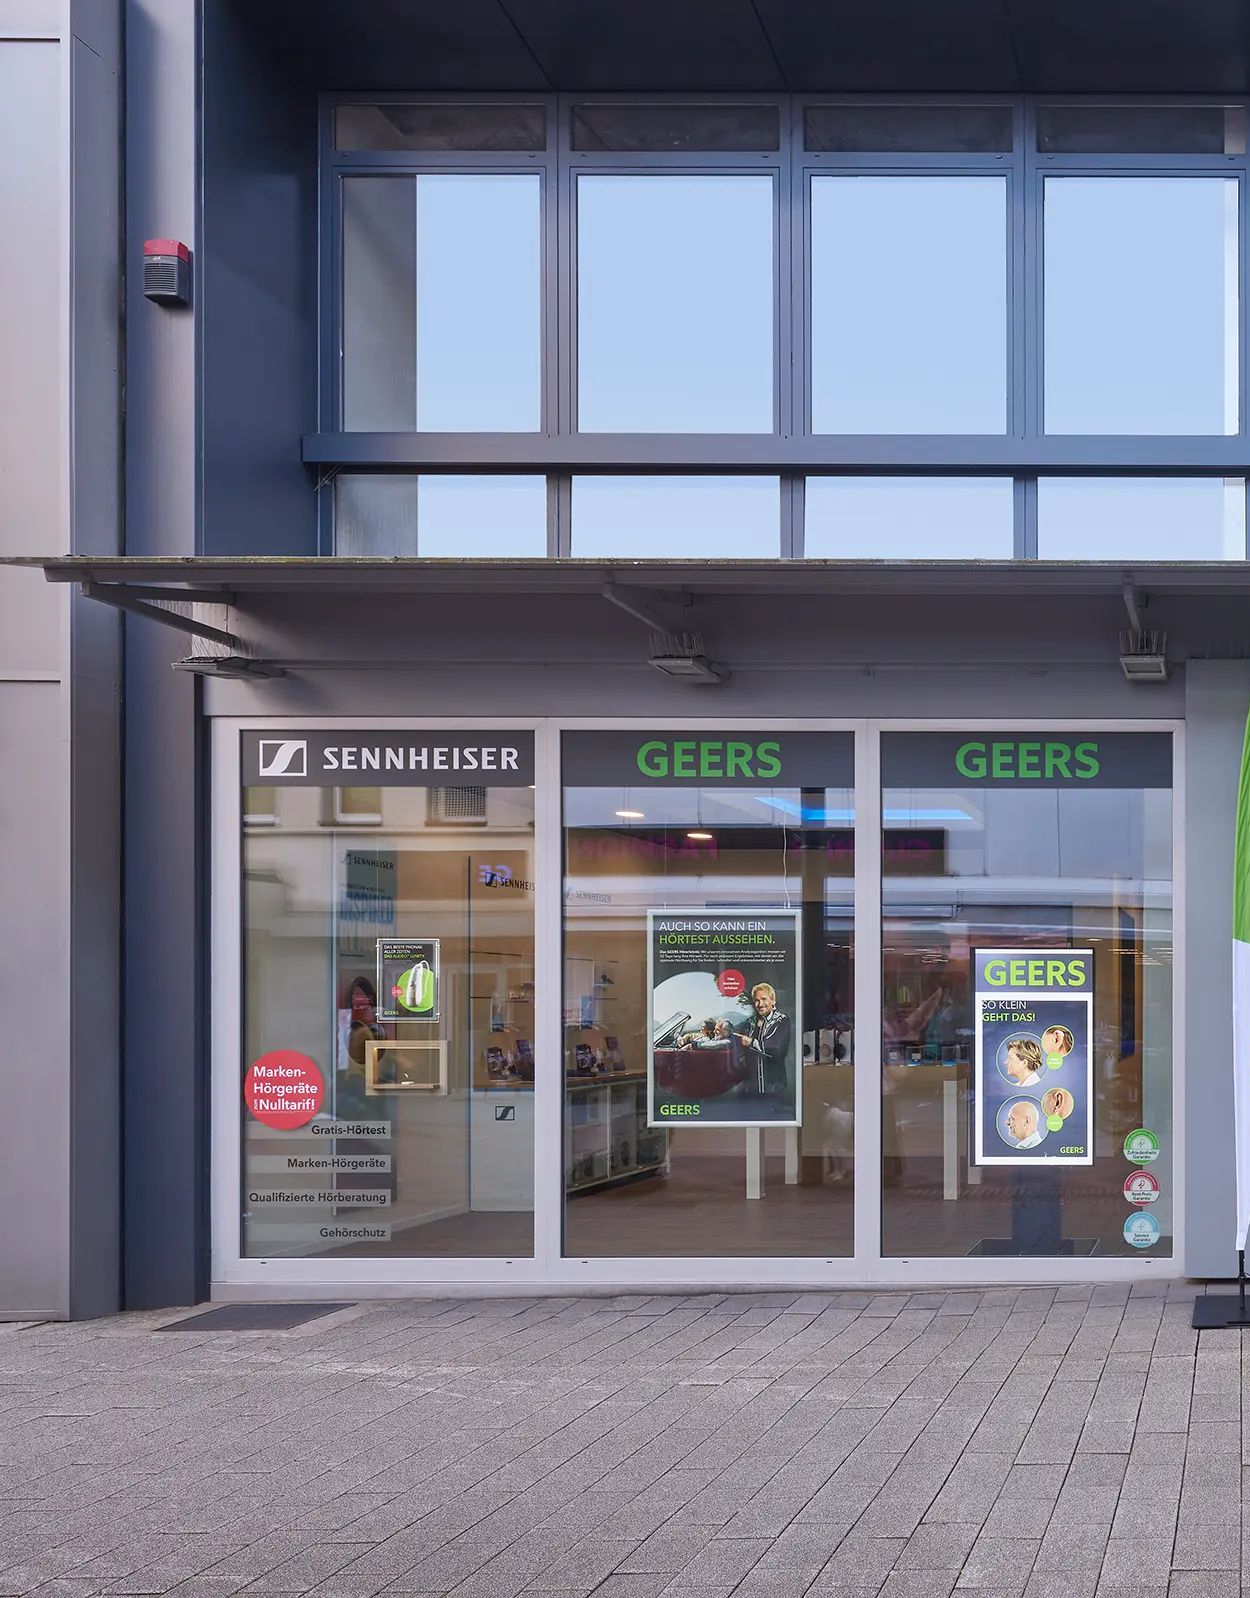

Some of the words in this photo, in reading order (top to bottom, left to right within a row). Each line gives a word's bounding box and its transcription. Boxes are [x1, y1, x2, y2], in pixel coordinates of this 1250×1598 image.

[323, 747, 519, 770] SENNHEISER
[636, 741, 782, 778] GEERS
[955, 742, 1100, 779] GEERS
[353, 856, 394, 870] SENNHEISER
[658, 921, 692, 931] AUCH
[694, 921, 711, 931] SO
[713, 921, 745, 931] KANN
[748, 921, 766, 931] EIN
[659, 931, 710, 944] HÖRTEST
[712, 934, 776, 944] AUSSEHEN.
[983, 959, 1087, 987] GEERS
[982, 1000, 997, 1010] SO
[999, 1000, 1027, 1010] KLEIN
[982, 1013, 1009, 1022] GEHT
[1012, 1013, 1036, 1022] DAS!
[253, 1065, 306, 1077] Marken-
[253, 1082, 318, 1097] Hörgeräte
[259, 1098, 315, 1110] Nulltarif!
[660, 1104, 700, 1116] GEERS
[311, 1124, 386, 1135] Gratis-Hörtest
[1059, 1146, 1084, 1154] GEERS
[287, 1157, 386, 1171] Marken-Hörgeräte
[249, 1192, 315, 1204] Qualifizierte
[318, 1192, 386, 1205] Hörberatung
[319, 1226, 386, 1238] Gehörschutz
